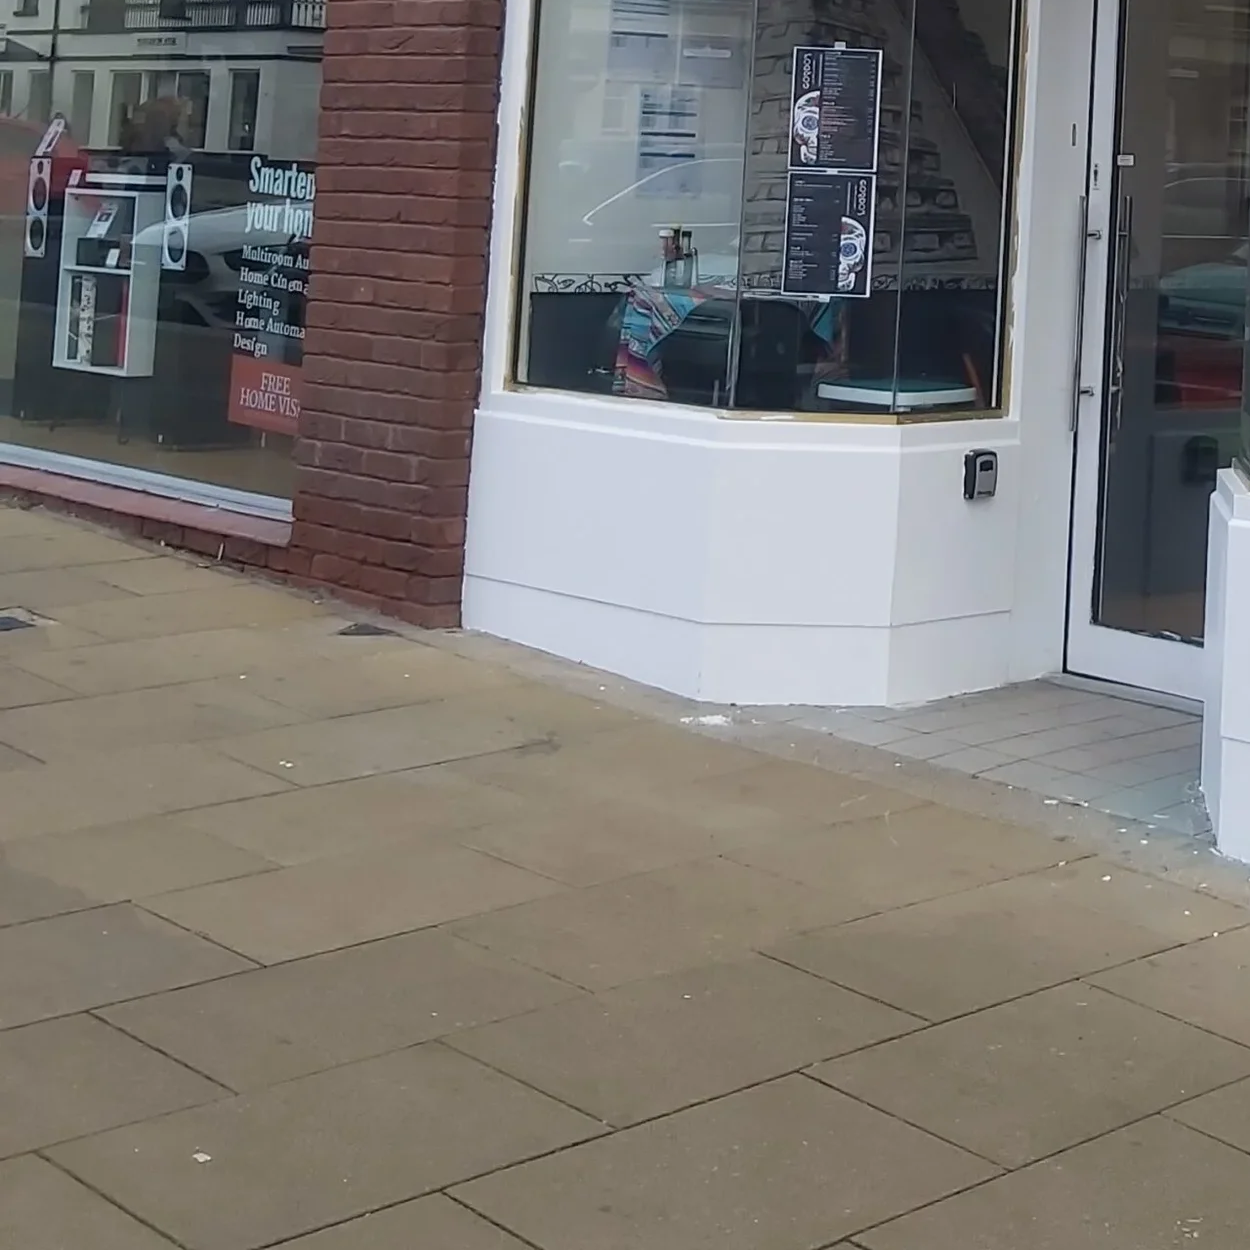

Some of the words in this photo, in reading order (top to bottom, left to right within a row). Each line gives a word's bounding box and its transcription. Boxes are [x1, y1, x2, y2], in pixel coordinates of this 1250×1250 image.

[244, 201, 281, 234] your
[240, 266, 269, 286] Home
[238, 288, 280, 315] Lighting
[236, 310, 265, 331] Home
[233, 332, 268, 358] Design
[260, 371, 291, 396] FREE
[240, 387, 276, 412] HOME
